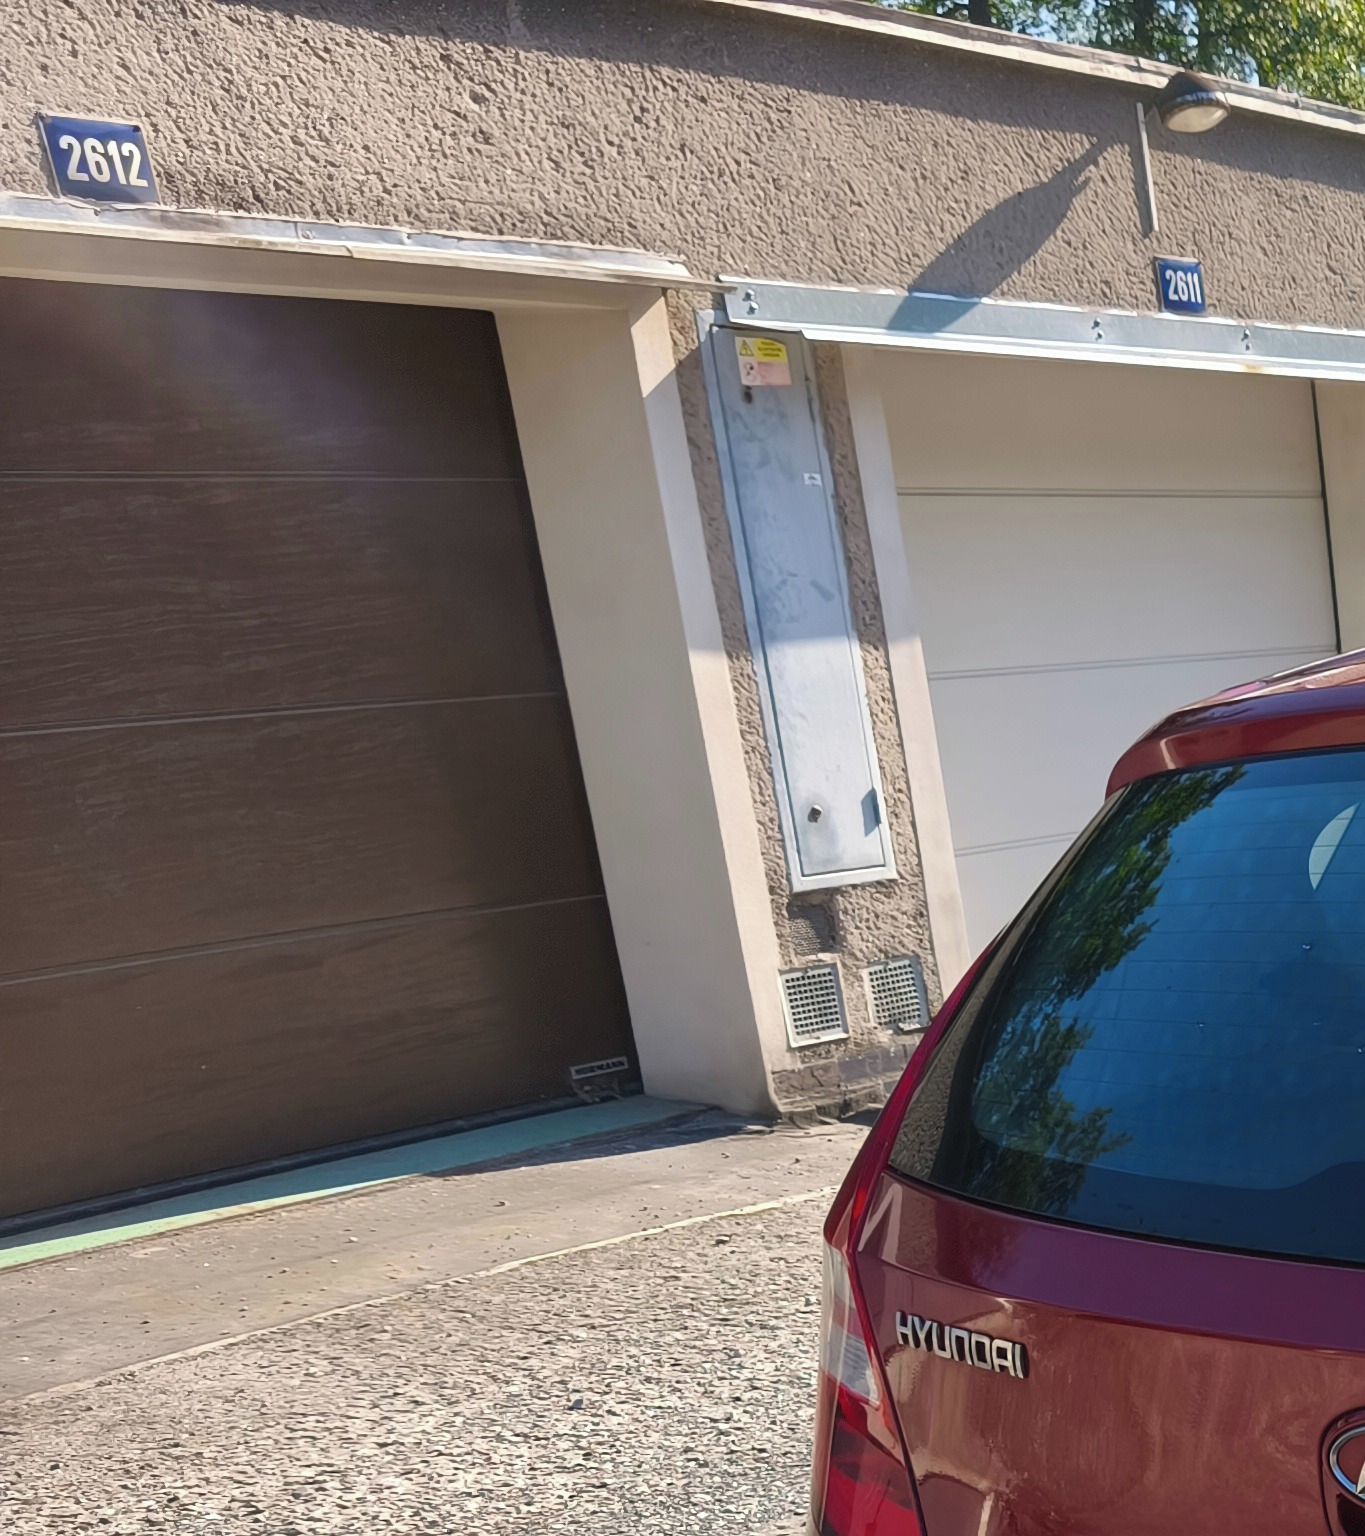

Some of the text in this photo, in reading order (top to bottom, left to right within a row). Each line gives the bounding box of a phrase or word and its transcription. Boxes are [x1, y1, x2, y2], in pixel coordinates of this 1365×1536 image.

[59, 135, 148, 187] 2612
[1165, 269, 1202, 304] 2611
[896, 1311, 1025, 1379] HYUNDAI
